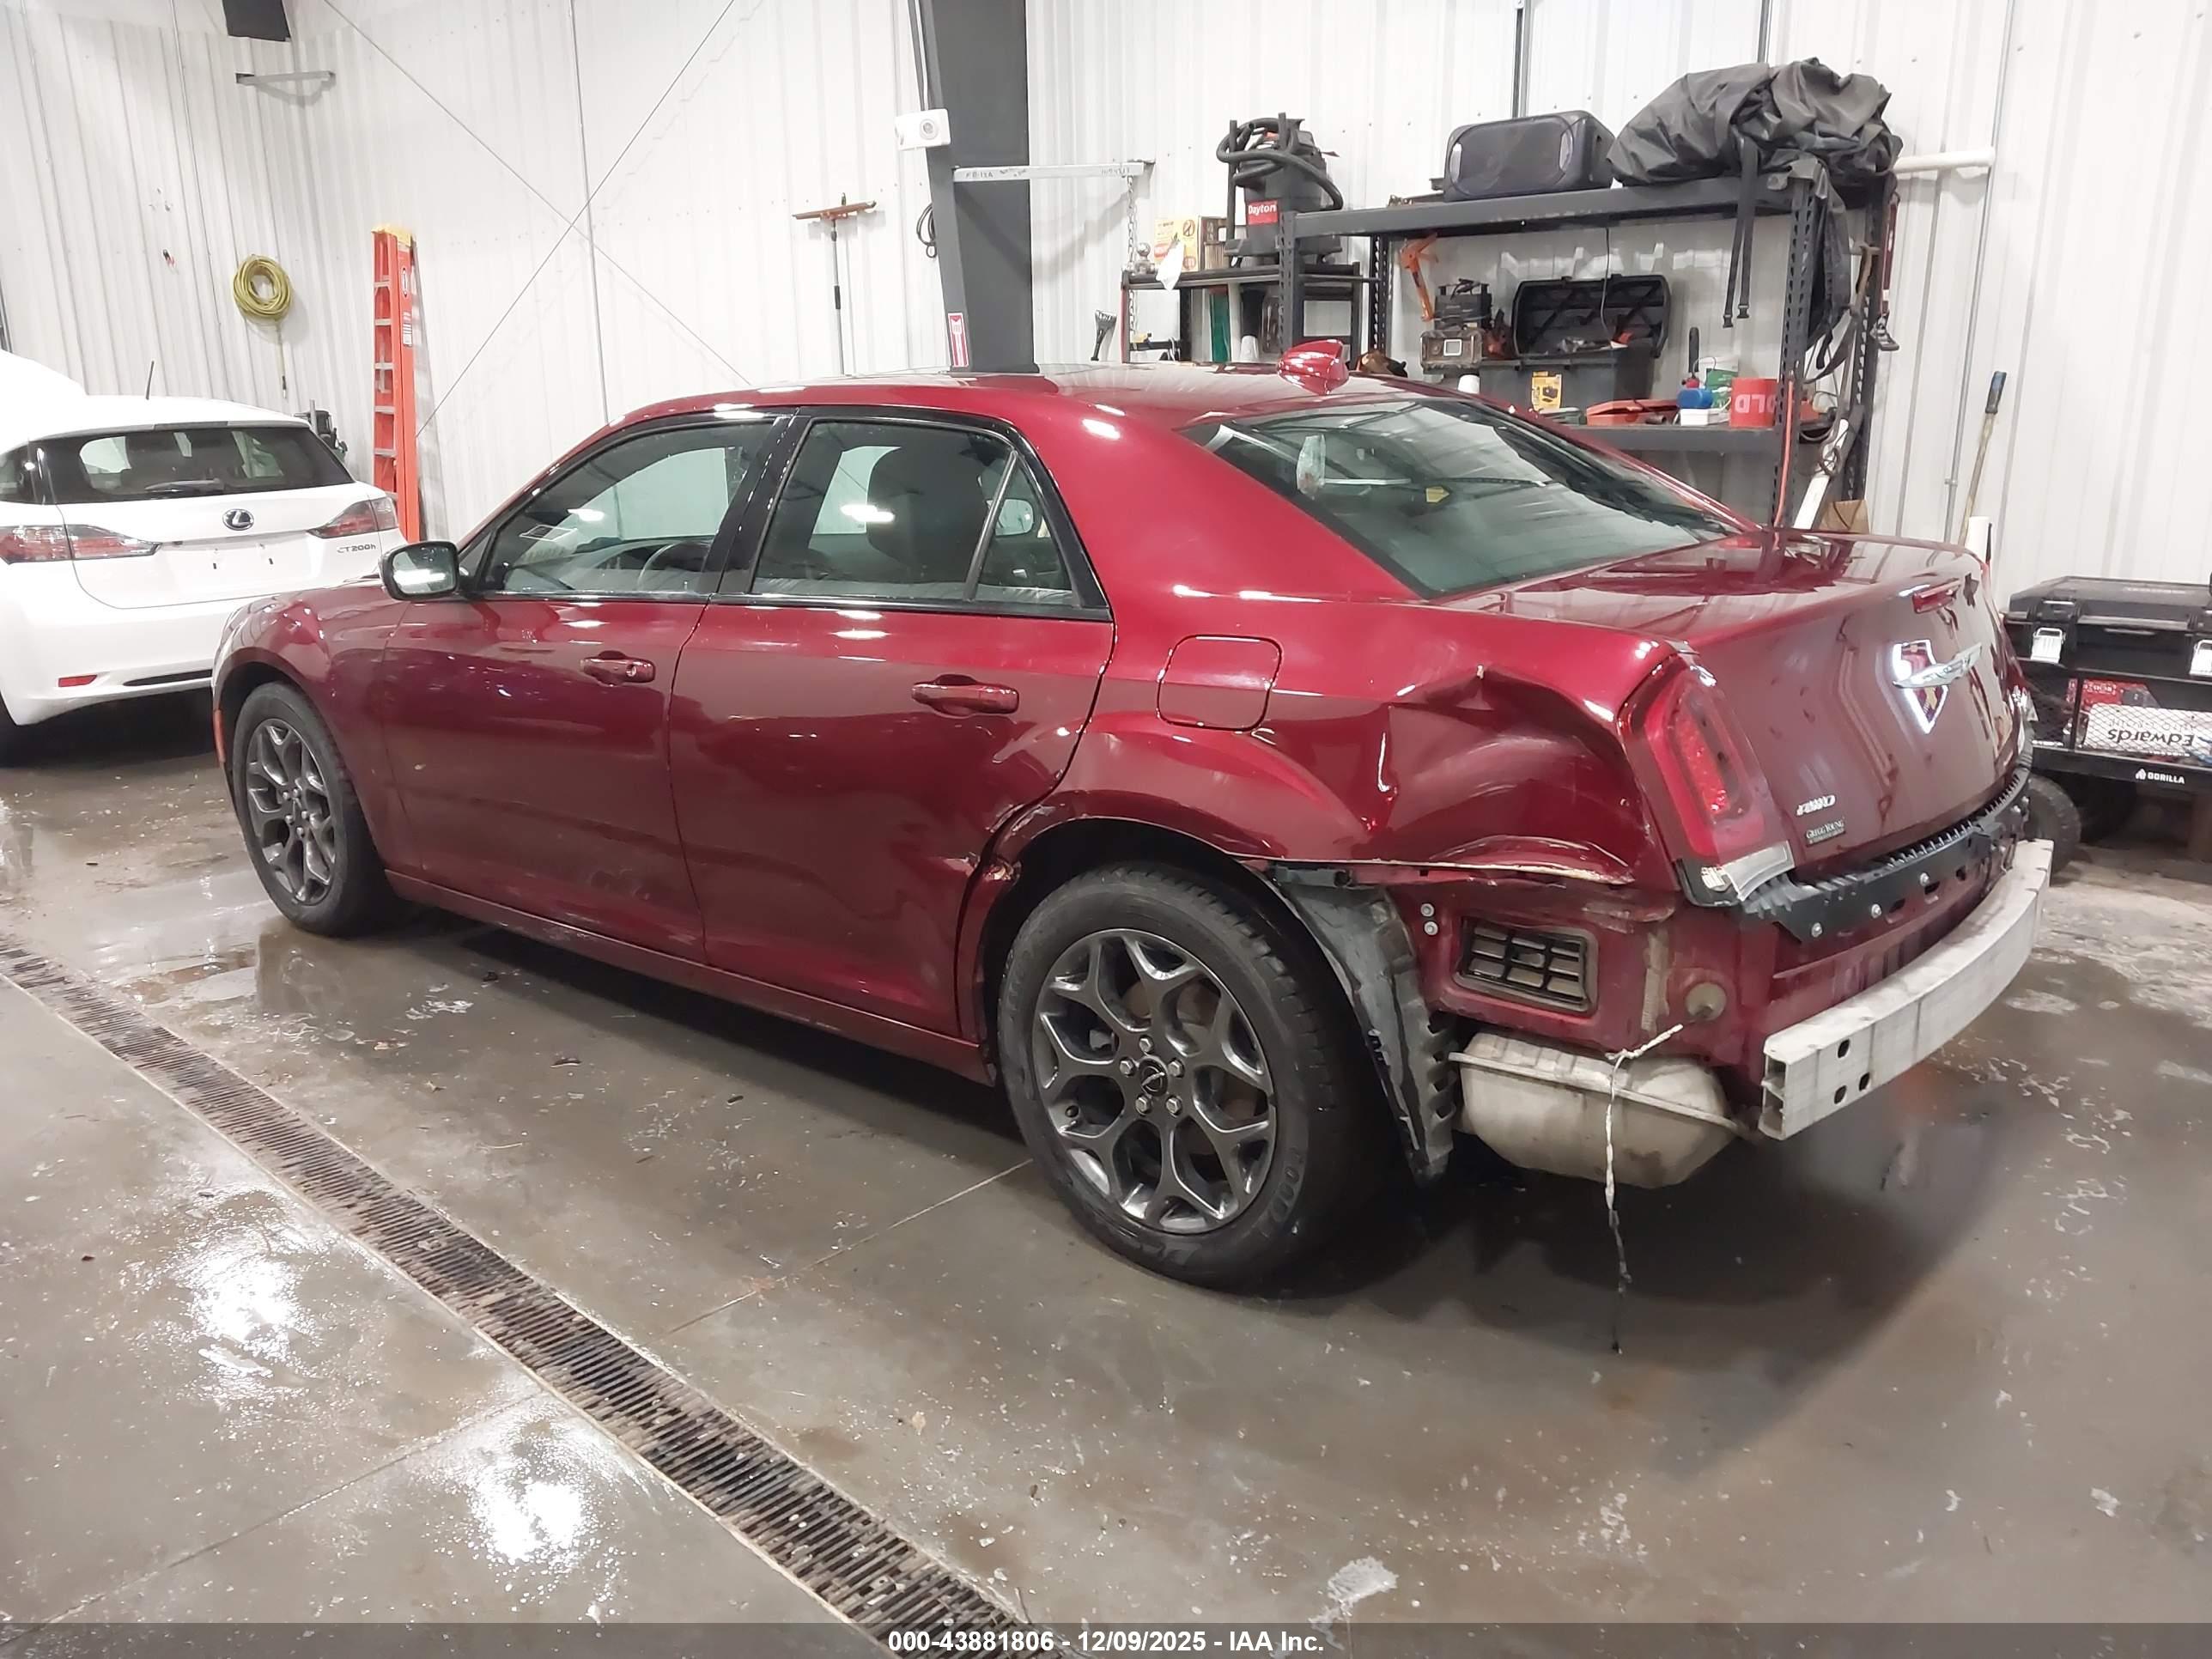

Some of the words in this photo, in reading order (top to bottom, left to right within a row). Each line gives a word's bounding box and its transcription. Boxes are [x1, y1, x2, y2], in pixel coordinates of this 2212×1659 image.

[1248, 204, 1276, 216] Dayton
[2107, 729, 2195, 746] Edwards
[2147, 771, 2185, 784] GORILLA
